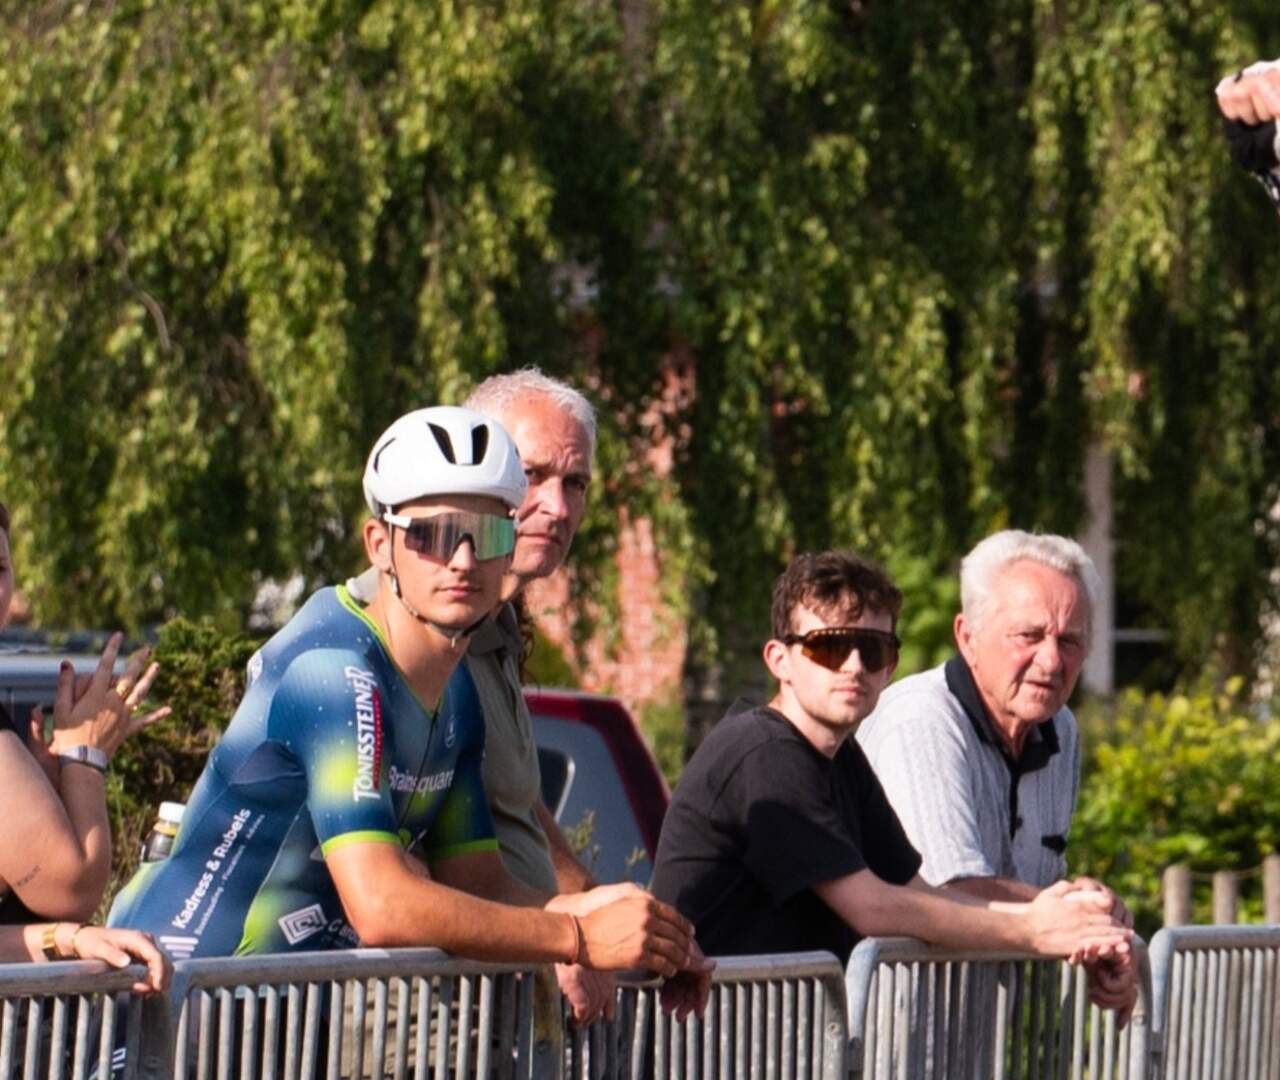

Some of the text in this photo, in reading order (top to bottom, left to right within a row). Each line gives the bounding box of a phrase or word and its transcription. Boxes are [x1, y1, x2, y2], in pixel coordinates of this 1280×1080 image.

[213, 808, 251, 858] Rubels
[206, 859, 221, 873] &
[171, 871, 214, 930] Kadress
